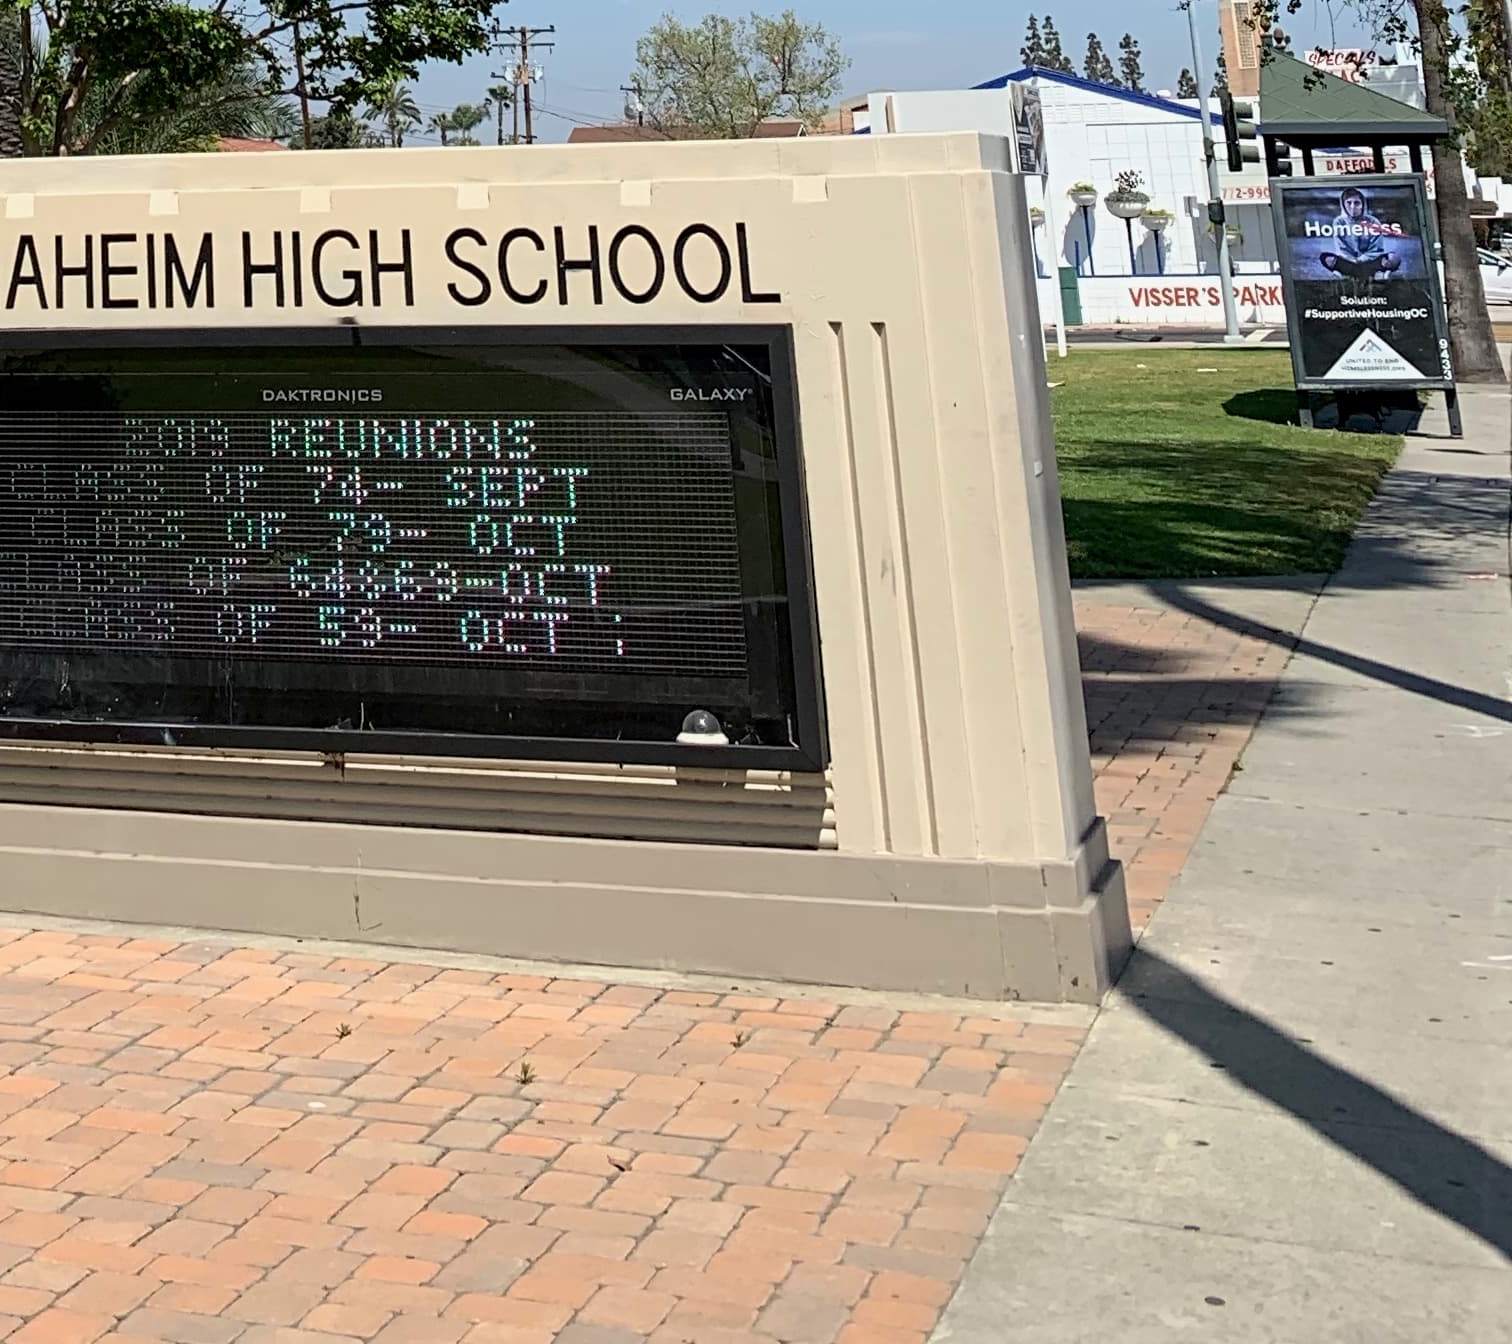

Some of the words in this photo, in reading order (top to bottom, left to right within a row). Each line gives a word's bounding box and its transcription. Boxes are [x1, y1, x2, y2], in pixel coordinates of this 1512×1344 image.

[1304, 220, 1403, 237] Homeless
[241, 228, 412, 310] HIGH
[444, 221, 783, 308] SCHOOL
[1128, 286, 1221, 307] VISSER'S
[1304, 307, 1429, 321] #SupportiveHousingOC
[1340, 295, 1388, 306] Solution:
[1438, 338, 1453, 381] 9433
[262, 389, 384, 403] DAKTRONICS
[124, 418, 230, 458] 2019
[270, 418, 537, 460] REUNIONS
[10, 462, 167, 502] CLASS
[204, 463, 265, 504] OF
[445, 466, 589, 509] SEPT
[30, 507, 186, 548] CLASS
[226, 510, 287, 550] OF
[468, 514, 578, 556] OCT
[187, 555, 248, 596] OF
[19, 598, 177, 641] CLASS
[216, 603, 277, 644] OF
[460, 609, 570, 655] OCT
